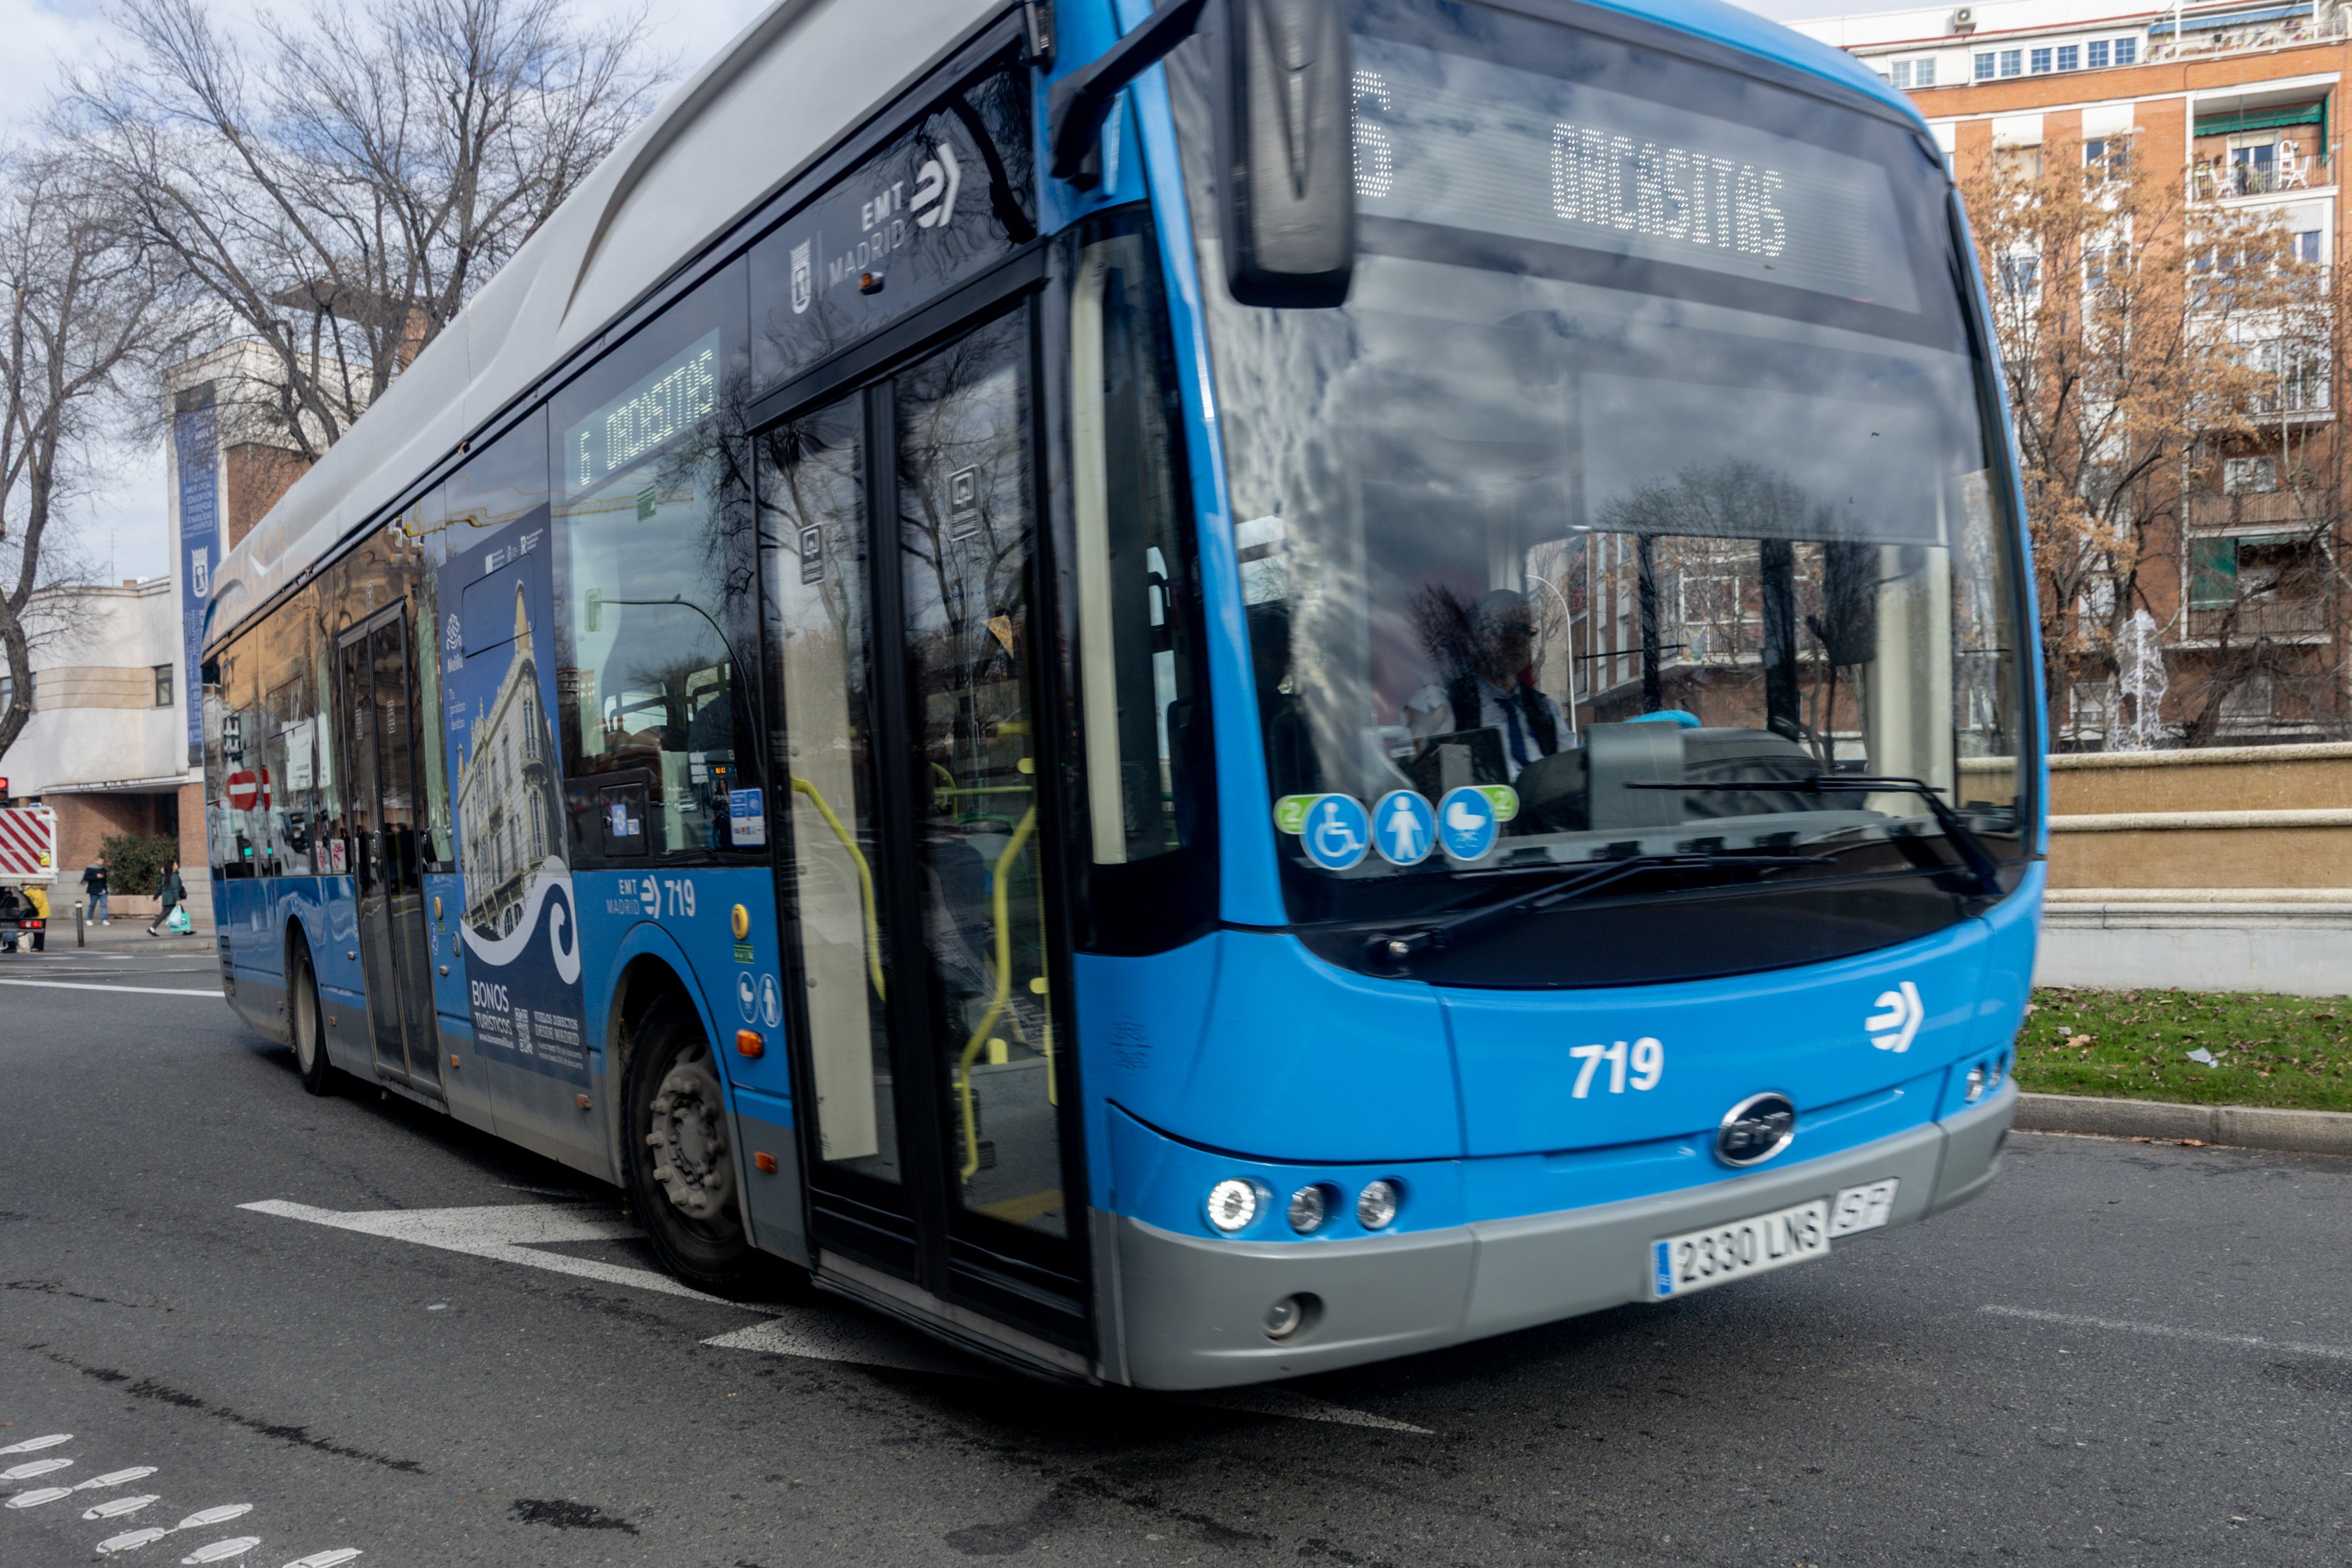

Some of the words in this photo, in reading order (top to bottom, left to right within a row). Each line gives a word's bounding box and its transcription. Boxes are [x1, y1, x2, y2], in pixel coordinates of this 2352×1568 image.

[1351, 71, 1392, 197] 6
[1551, 123, 1785, 257] ORCASITAS
[862, 180, 904, 232] EMT
[828, 219, 905, 288] MADRID
[579, 431, 591, 486] 6
[606, 349, 713, 471] ORCASITAS
[606, 898, 641, 915] MADRID
[619, 879, 637, 895] EMT
[664, 878, 696, 917] 719
[471, 979, 509, 1013] BONOS
[474, 1010, 513, 1035] TURÍSTICOS
[533, 1011, 553, 1025] VUELOS
[553, 1015, 579, 1030] DIRECTOS
[534, 1024, 554, 1040] DESDE
[554, 1028, 579, 1046] MADRID
[1569, 1036, 1665, 1099] 719
[1838, 1186, 1894, 1230] SP
[1677, 1226, 1759, 1284] 2330
[1766, 1210, 1821, 1260] LNS
